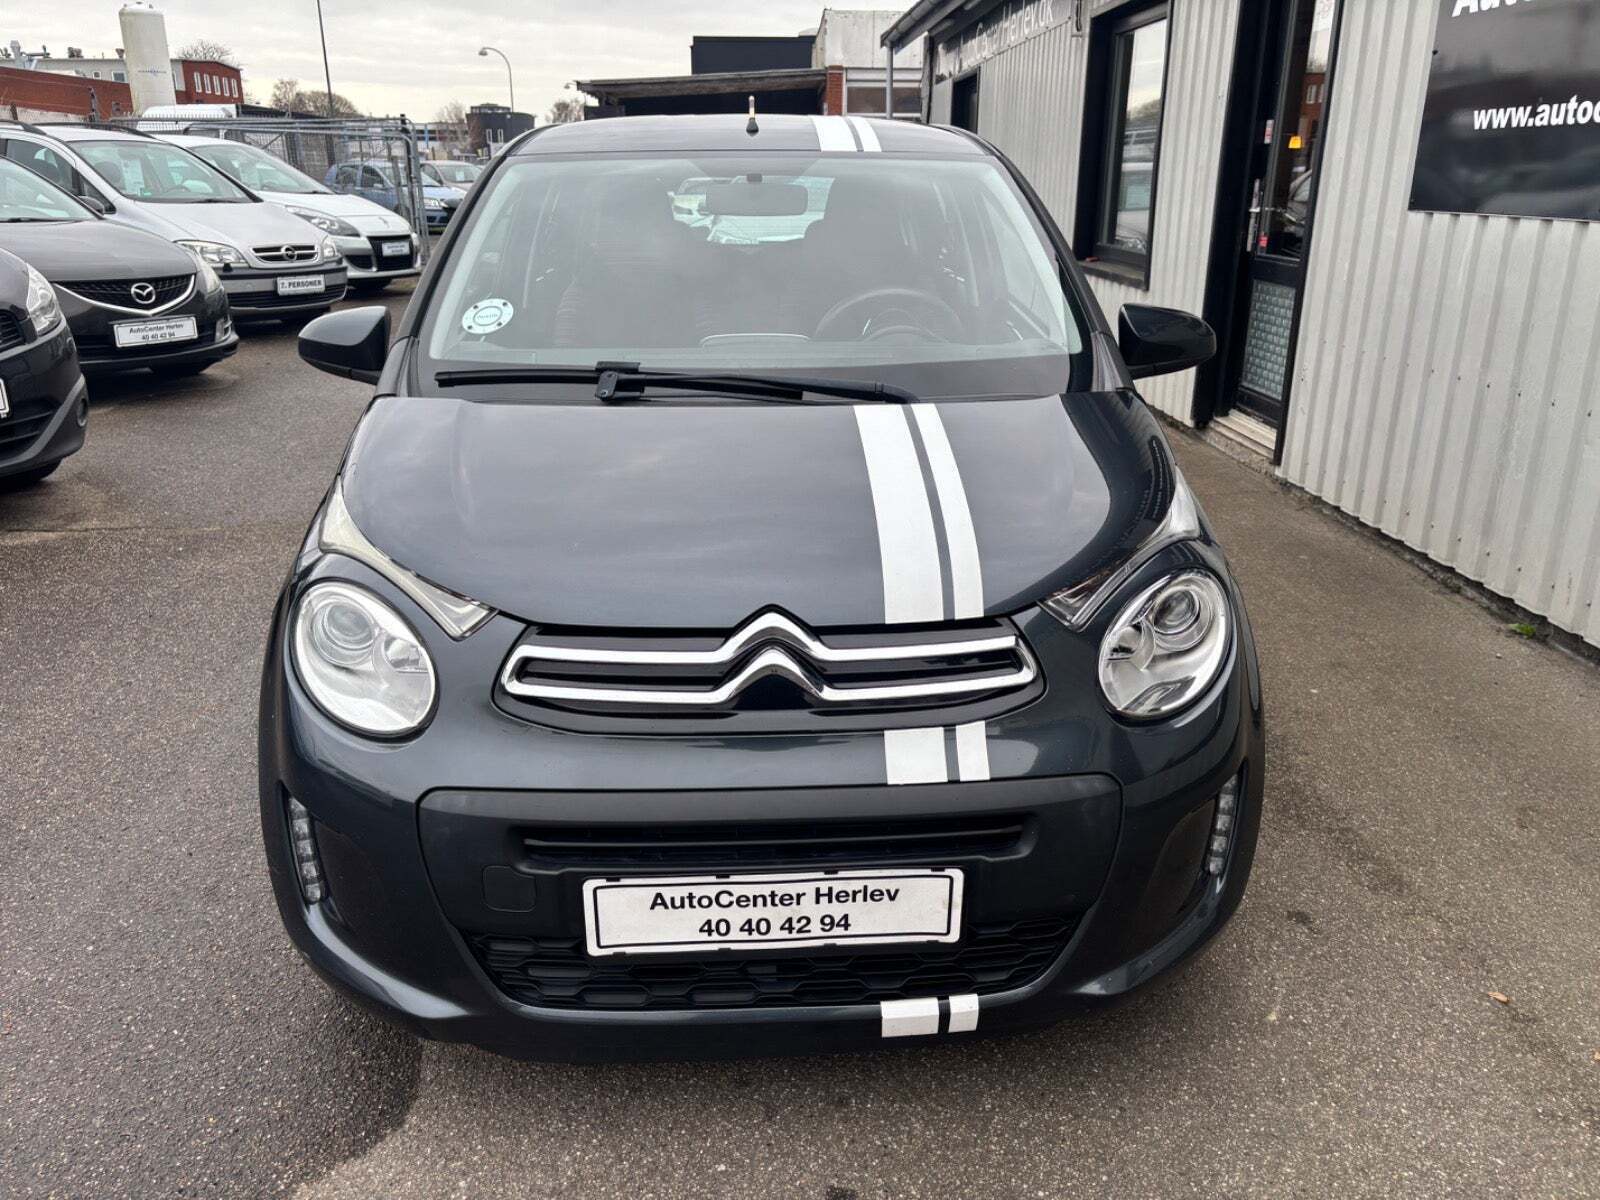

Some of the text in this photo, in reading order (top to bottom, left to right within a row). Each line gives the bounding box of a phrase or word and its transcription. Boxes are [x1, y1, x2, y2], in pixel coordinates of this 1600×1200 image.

[288, 280, 322, 288] PERSONER
[129, 324, 164, 334] AutoCenter
[649, 885, 901, 911] AutoCenter Herlev
[698, 913, 852, 938] 40 40 42 94
